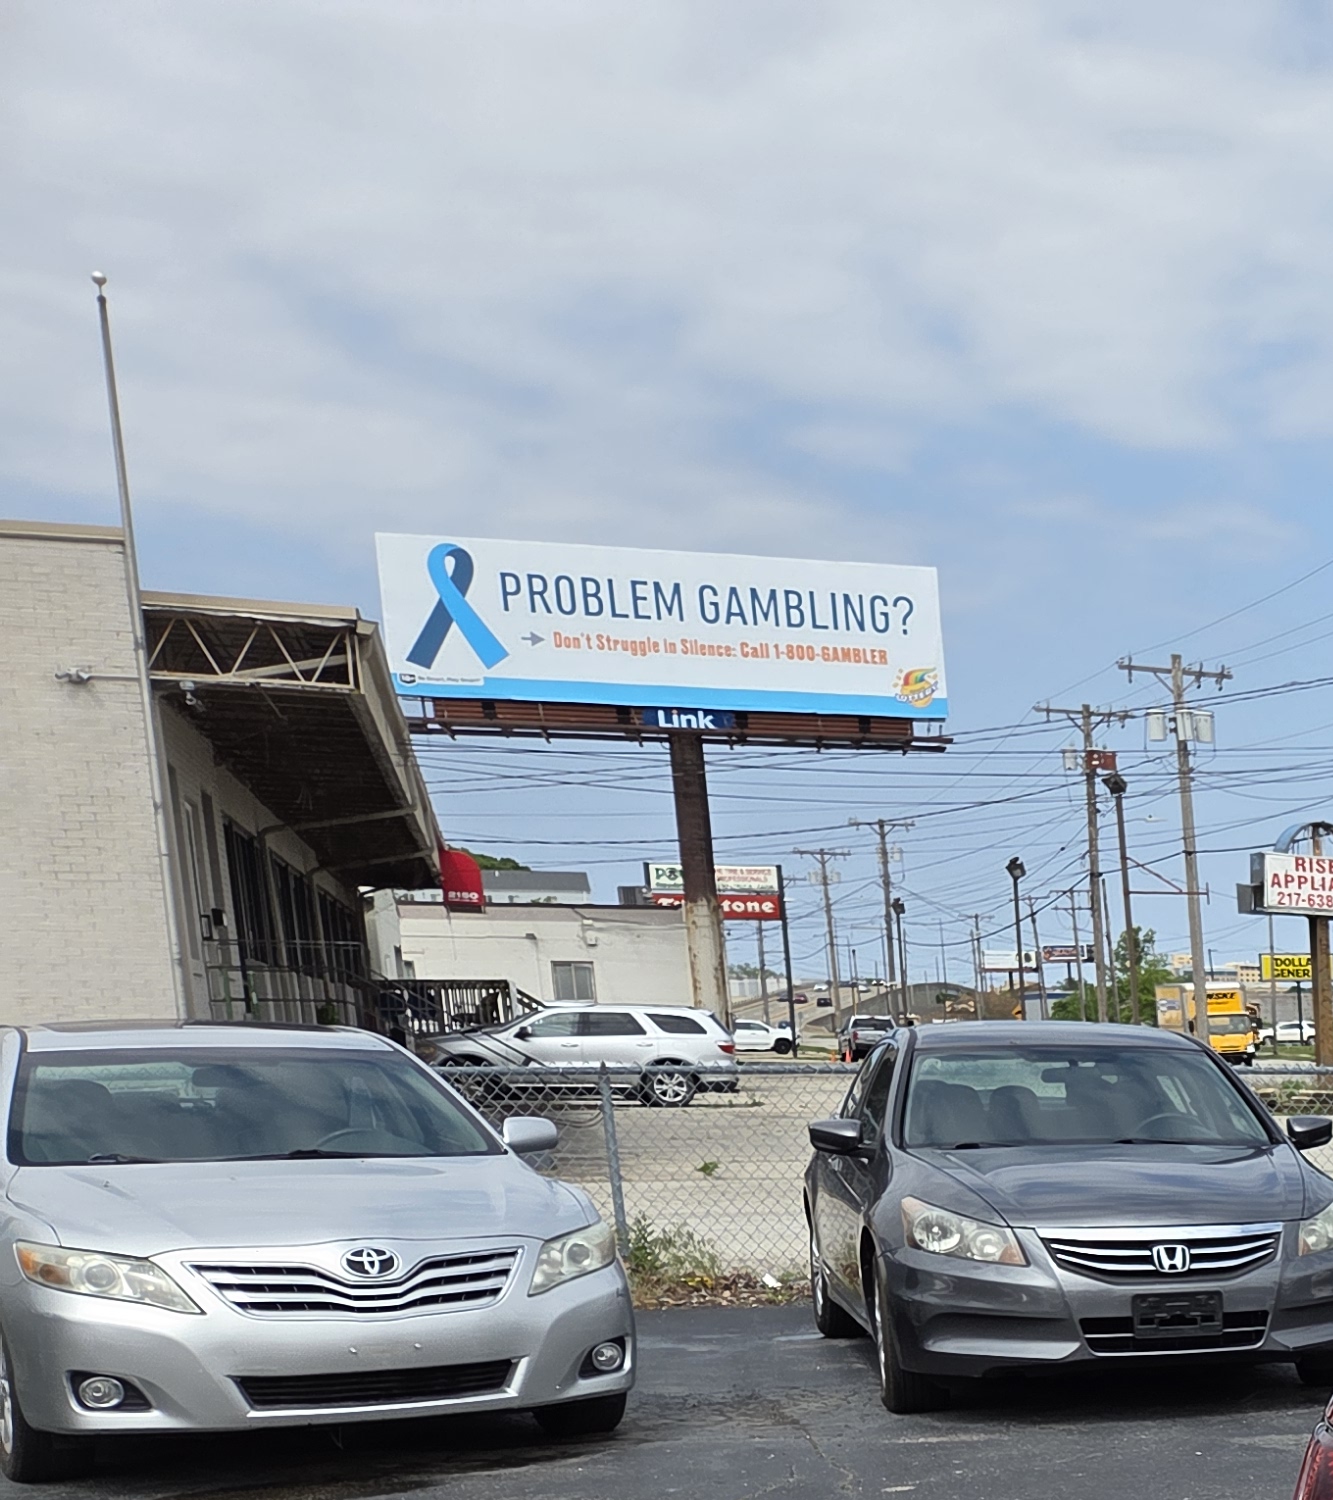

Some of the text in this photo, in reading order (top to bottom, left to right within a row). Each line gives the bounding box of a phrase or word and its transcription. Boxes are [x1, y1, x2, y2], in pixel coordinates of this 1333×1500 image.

[499, 571, 915, 636] PROBLEM GAMBLING?
[553, 631, 593, 650] Don't
[596, 633, 660, 657] Struggle
[680, 638, 737, 658] Silence:
[740, 641, 770, 659] Call
[773, 643, 888, 665] 1-800-GAMBLER
[657, 709, 718, 730] Link
[1274, 957, 1312, 968] DOLLA
[1274, 968, 1311, 978] GENER
